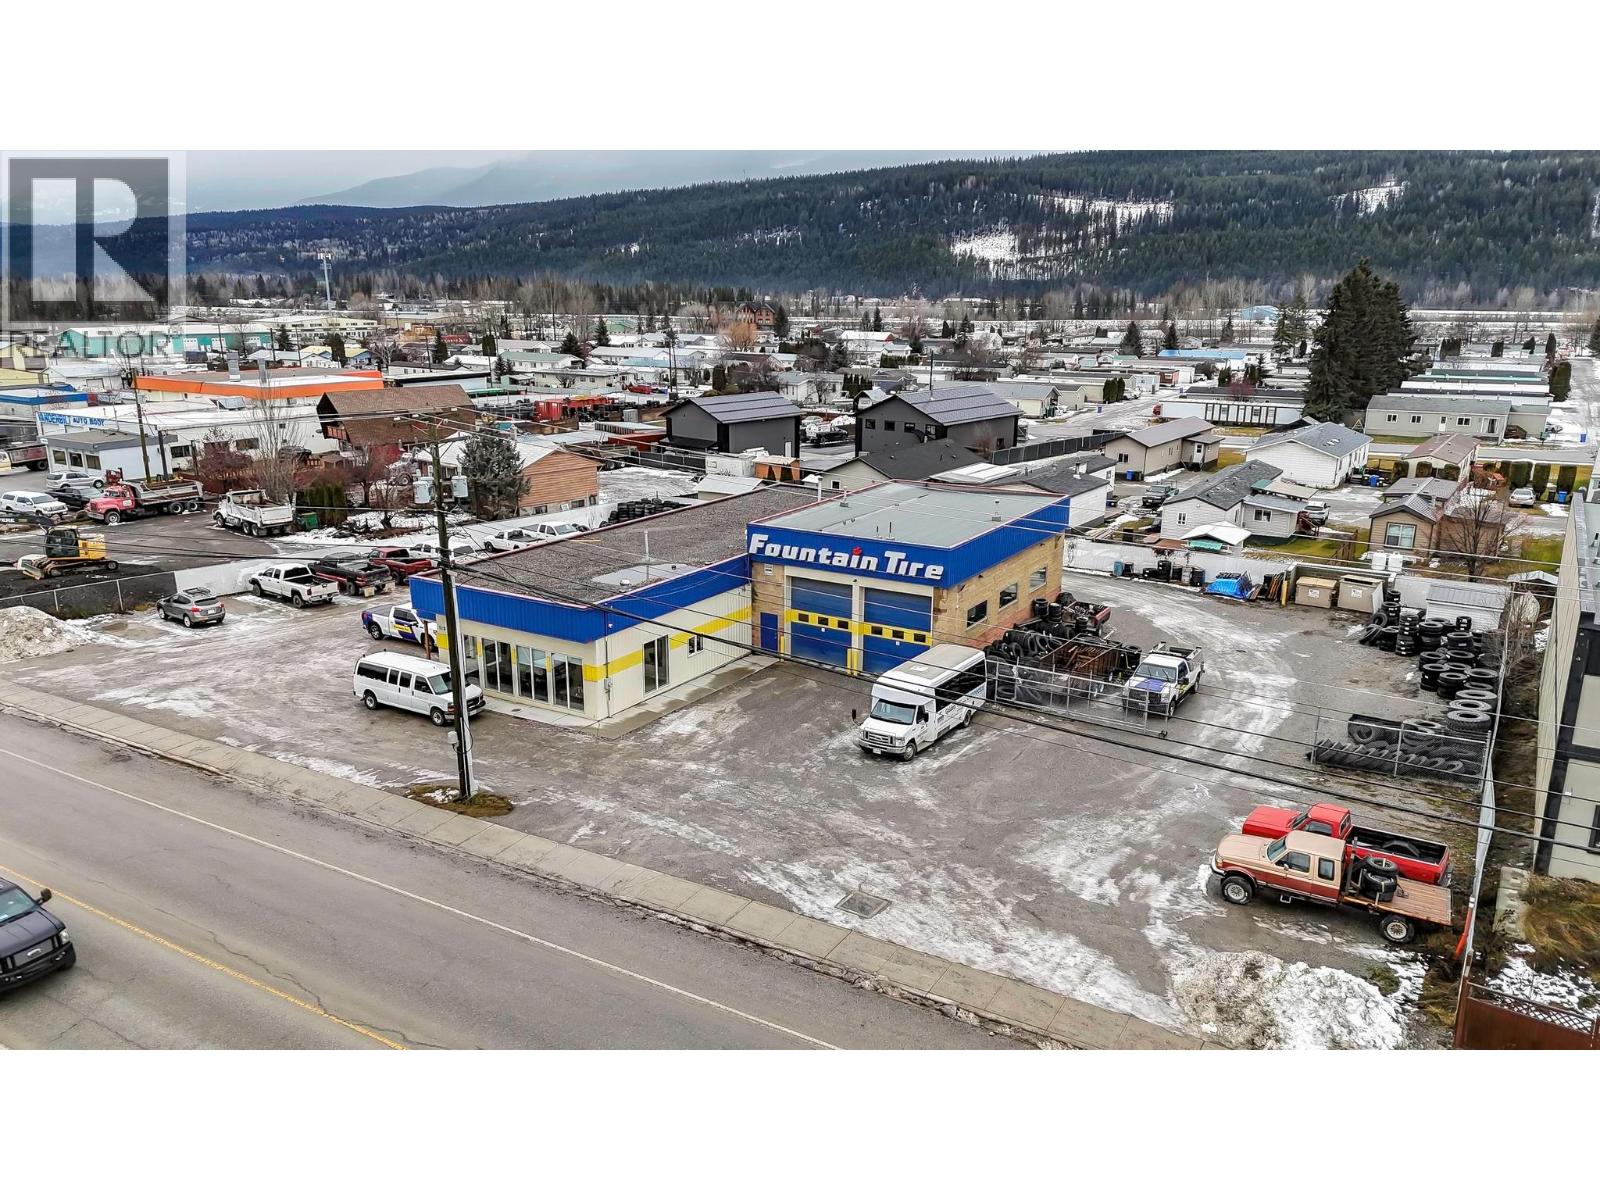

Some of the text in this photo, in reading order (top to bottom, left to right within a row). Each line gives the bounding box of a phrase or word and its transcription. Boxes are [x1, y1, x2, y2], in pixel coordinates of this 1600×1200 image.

[89, 418, 105, 426] BODY
[749, 533, 945, 580] Fountain Tire
